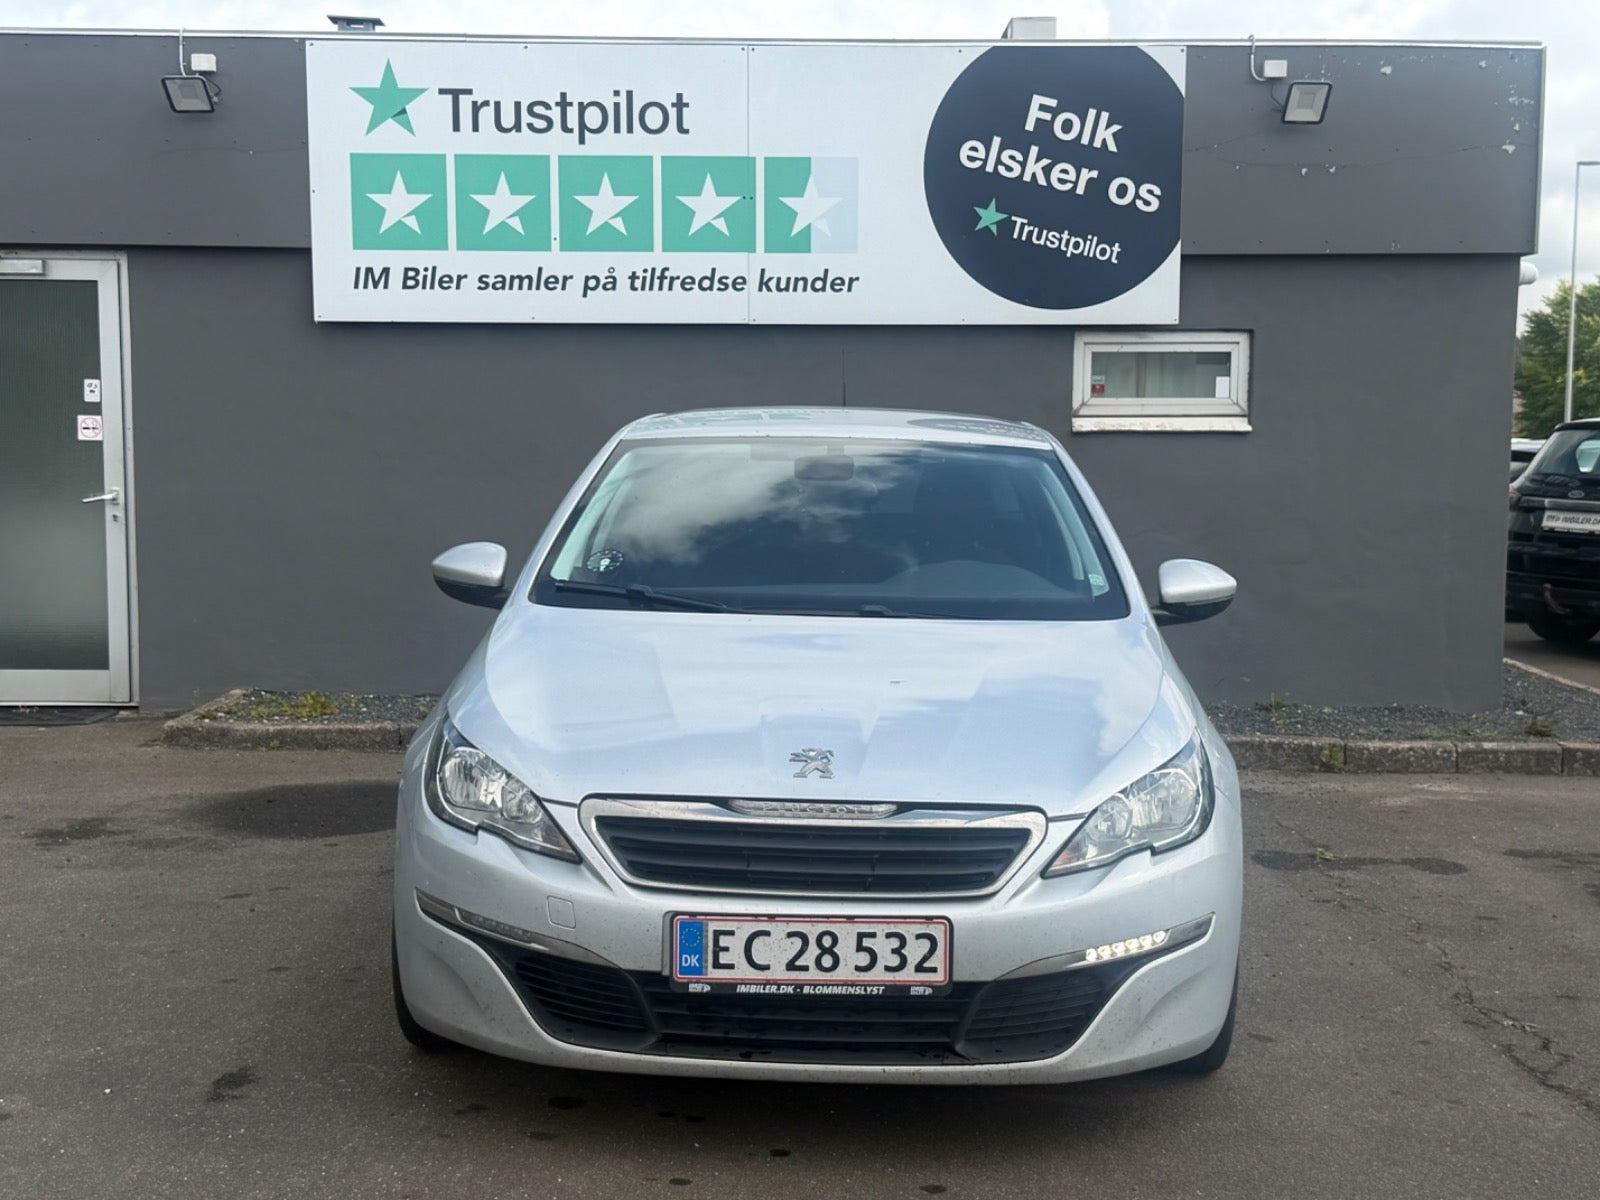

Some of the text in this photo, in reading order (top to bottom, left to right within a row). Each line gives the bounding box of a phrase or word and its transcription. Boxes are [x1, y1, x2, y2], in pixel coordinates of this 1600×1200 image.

[437, 88, 690, 145] Trustpilot
[1024, 94, 1123, 152] Folk
[959, 135, 1162, 212] elsker os
[1011, 216, 1121, 263] Trustpilot
[353, 267, 860, 298] IM Biler samler på tilfredse kunder
[681, 955, 700, 967] DK
[712, 929, 939, 973] EC 28 532
[736, 984, 795, 994] IMBILER.DK
[802, 985, 885, 995] BLOMMENSLYST
